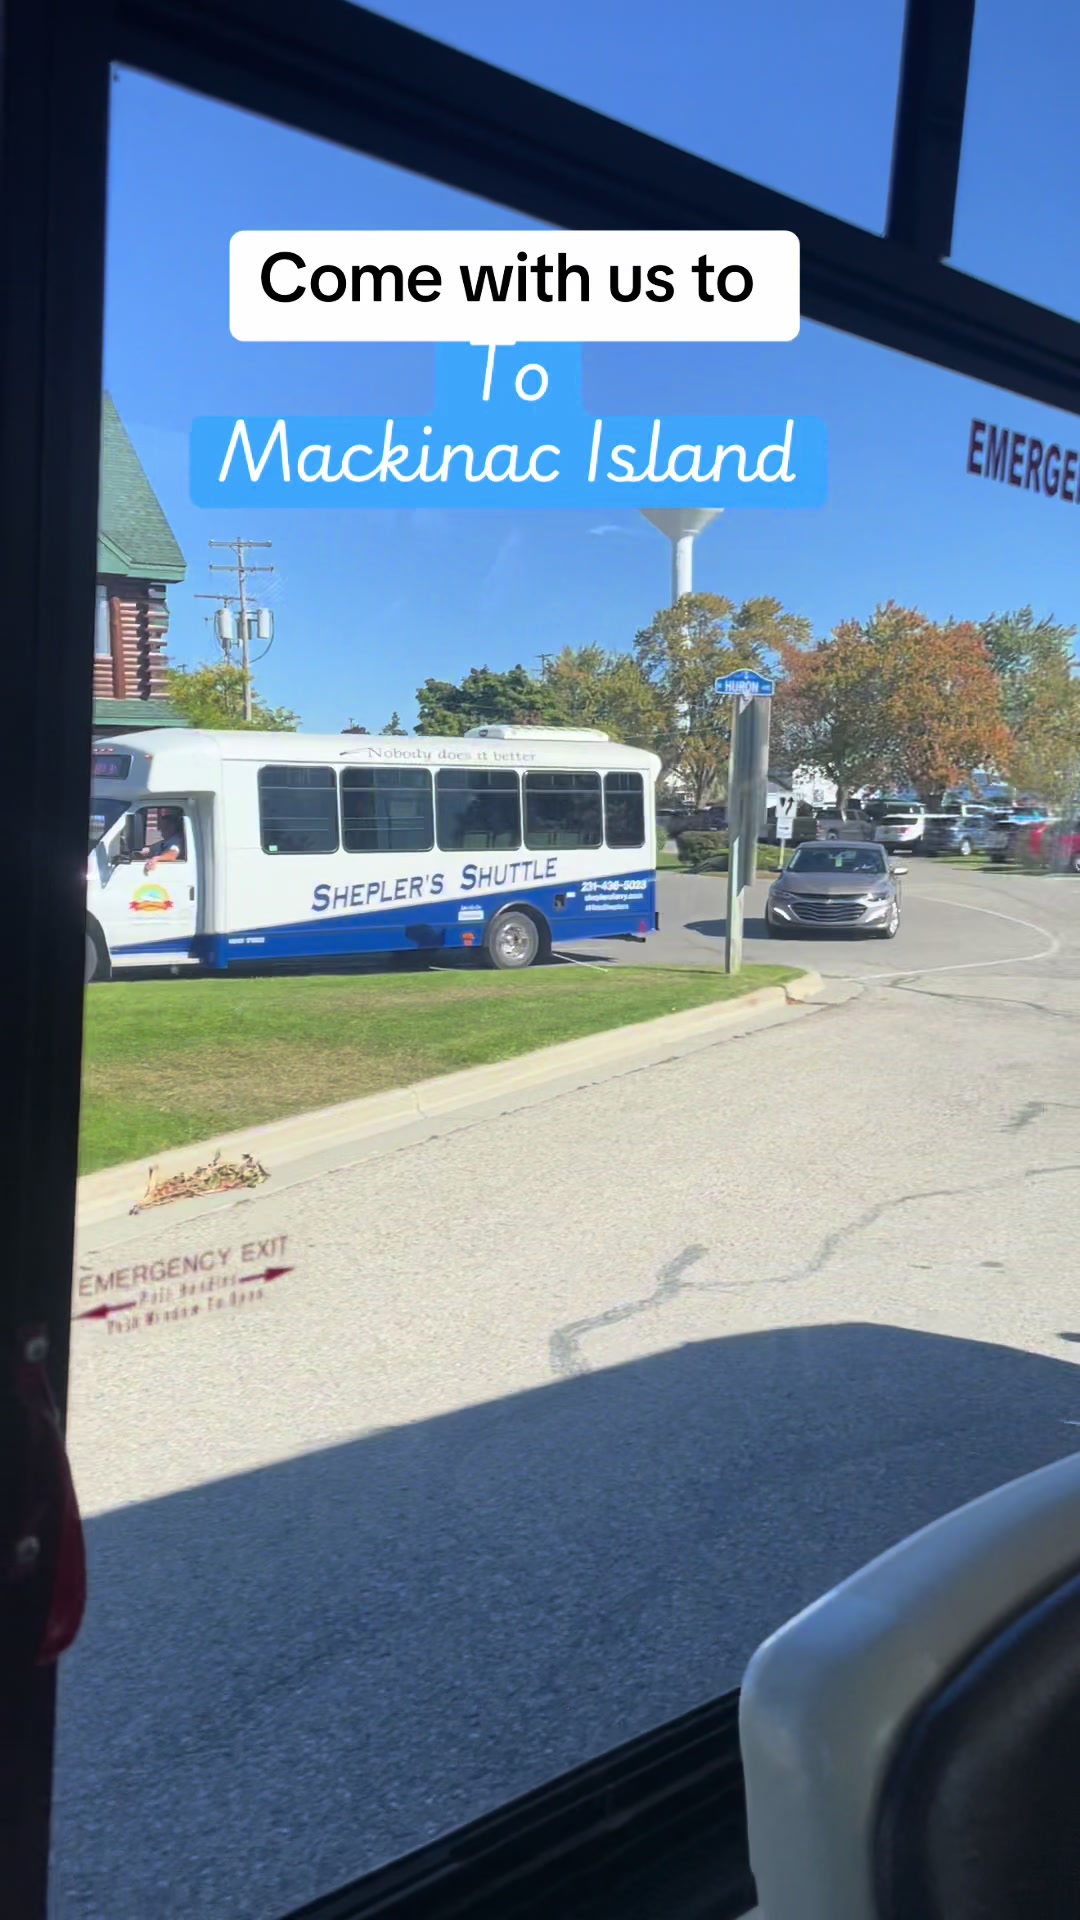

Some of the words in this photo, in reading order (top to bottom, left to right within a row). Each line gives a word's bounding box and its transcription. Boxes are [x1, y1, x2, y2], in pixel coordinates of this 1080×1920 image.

[966, 417, 1080, 505] EMERGE
[725, 680, 759, 692] HURON
[340, 747, 431, 761] Nobody
[438, 749, 471, 760] does
[477, 749, 488, 760] it
[493, 749, 537, 762] better
[311, 873, 445, 912] SHEPLER'S
[460, 857, 558, 890] SHUTTLE
[78, 1247, 233, 1297] EMERGENCY
[240, 1234, 289, 1263] EXIT
